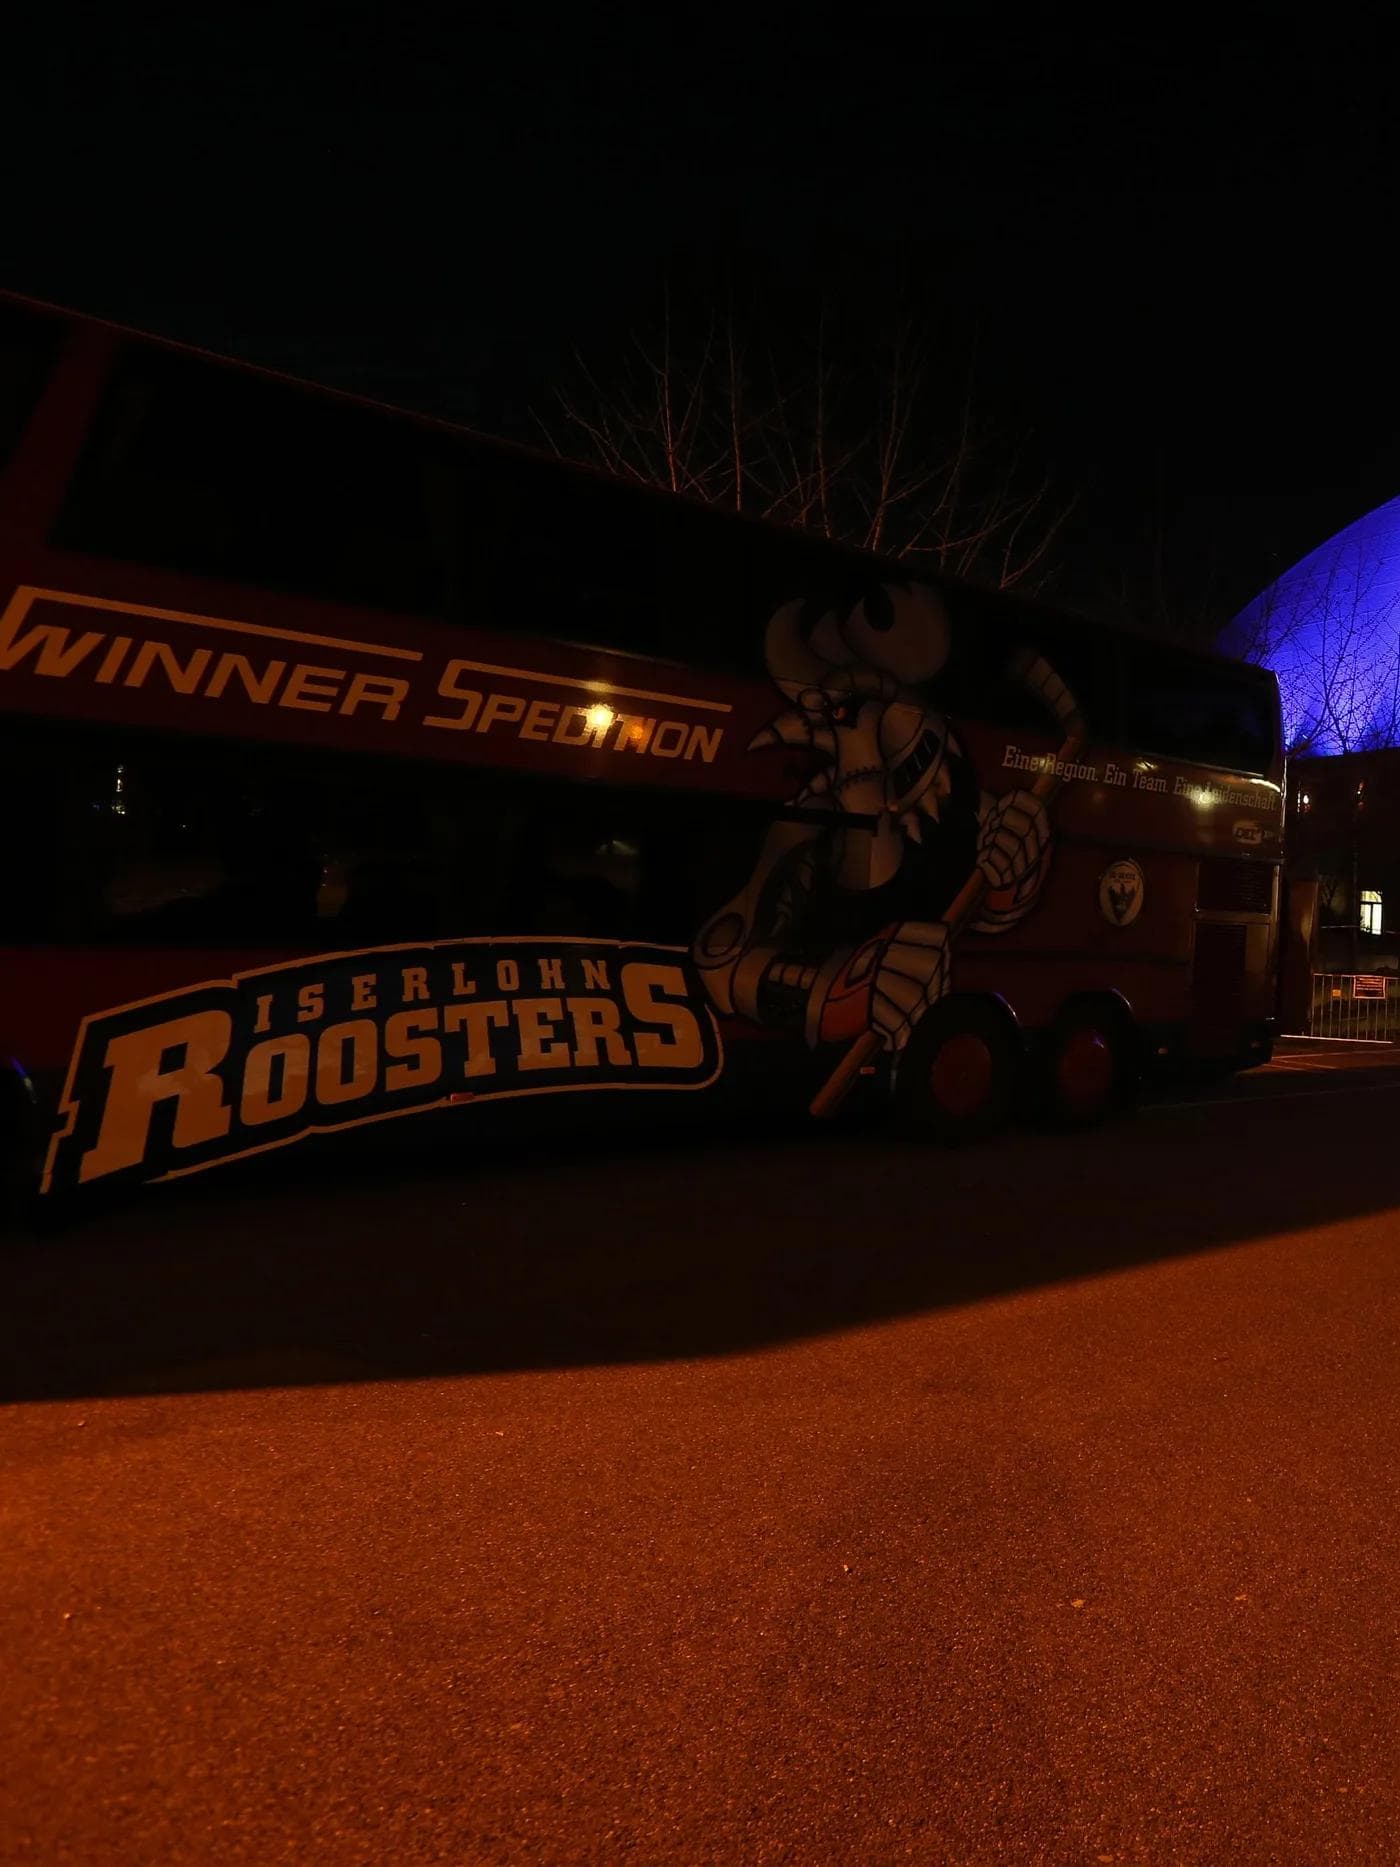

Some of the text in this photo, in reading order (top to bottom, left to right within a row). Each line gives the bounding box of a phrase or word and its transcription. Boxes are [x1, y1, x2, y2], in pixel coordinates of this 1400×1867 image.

[0, 586, 730, 763] WINNER SPEDITION
[1001, 744, 1040, 771] Eine
[1045, 752, 1098, 782] Region.
[1103, 763, 1127, 786] Ein
[1132, 769, 1168, 793] Team.
[253, 958, 613, 1034] ISERLOHN
[79, 961, 705, 1184] ROOSTERS
